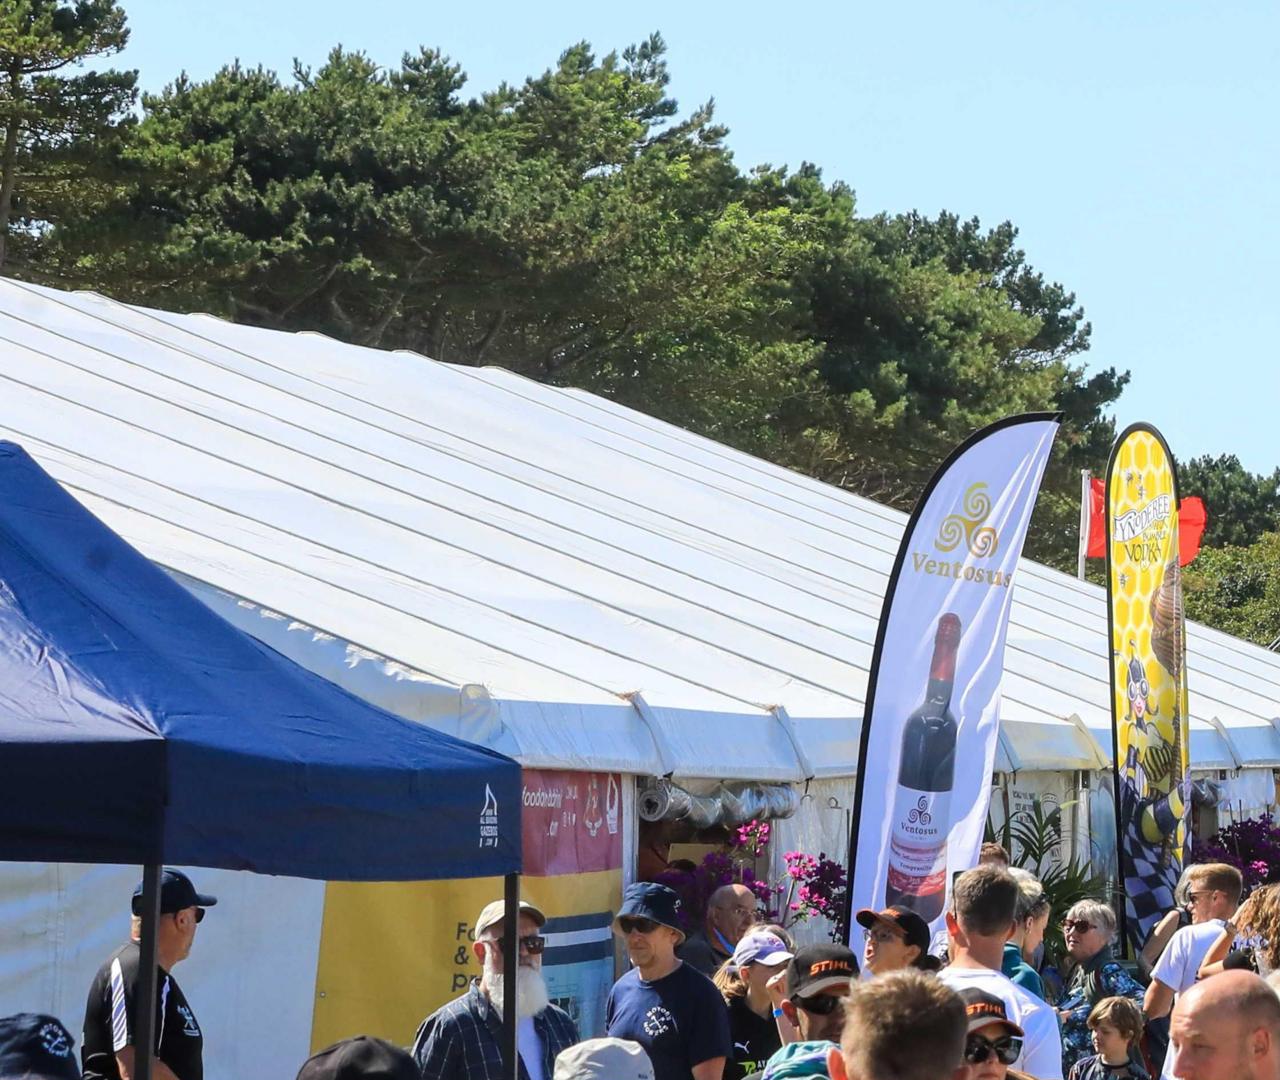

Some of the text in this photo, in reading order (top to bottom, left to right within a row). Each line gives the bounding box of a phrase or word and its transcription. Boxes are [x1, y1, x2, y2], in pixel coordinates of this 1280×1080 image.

[912, 552, 1012, 588] Ventosus
[901, 821, 938, 836] Ventosus
[454, 945, 469, 965] &
[809, 960, 853, 976] STIHL
